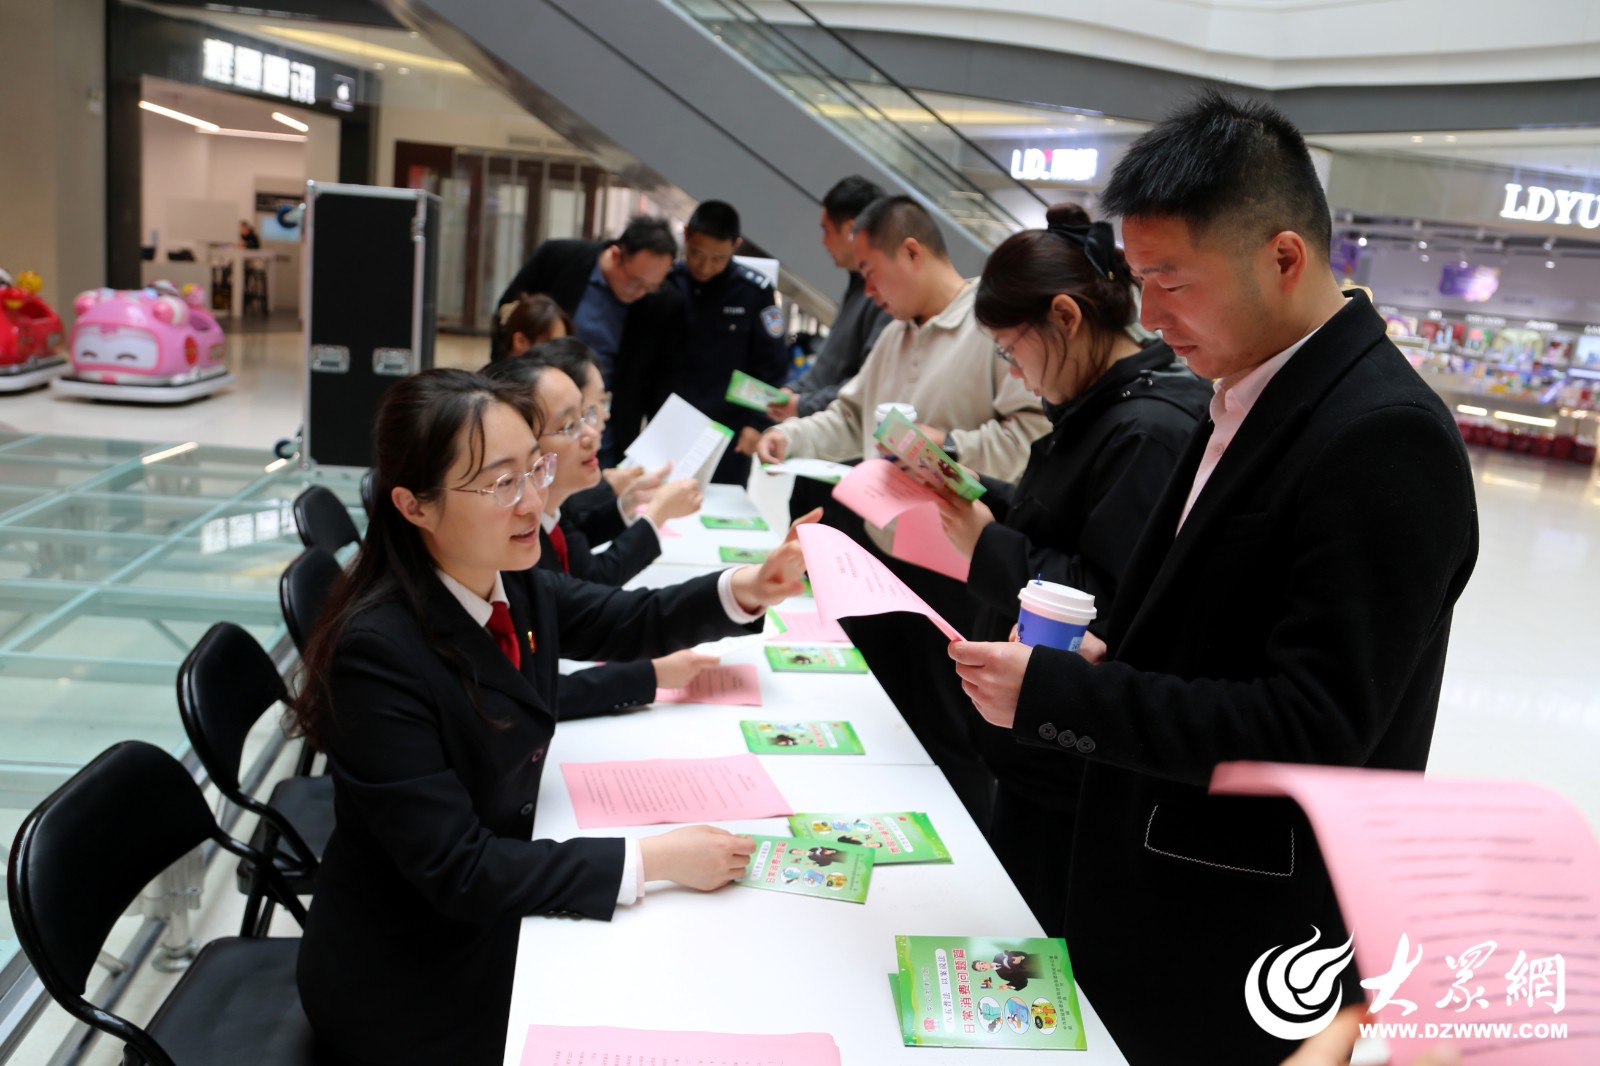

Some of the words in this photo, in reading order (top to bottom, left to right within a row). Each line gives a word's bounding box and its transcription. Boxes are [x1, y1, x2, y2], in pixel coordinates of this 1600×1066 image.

[952, 948, 976, 1034] 日常消费问题篇
